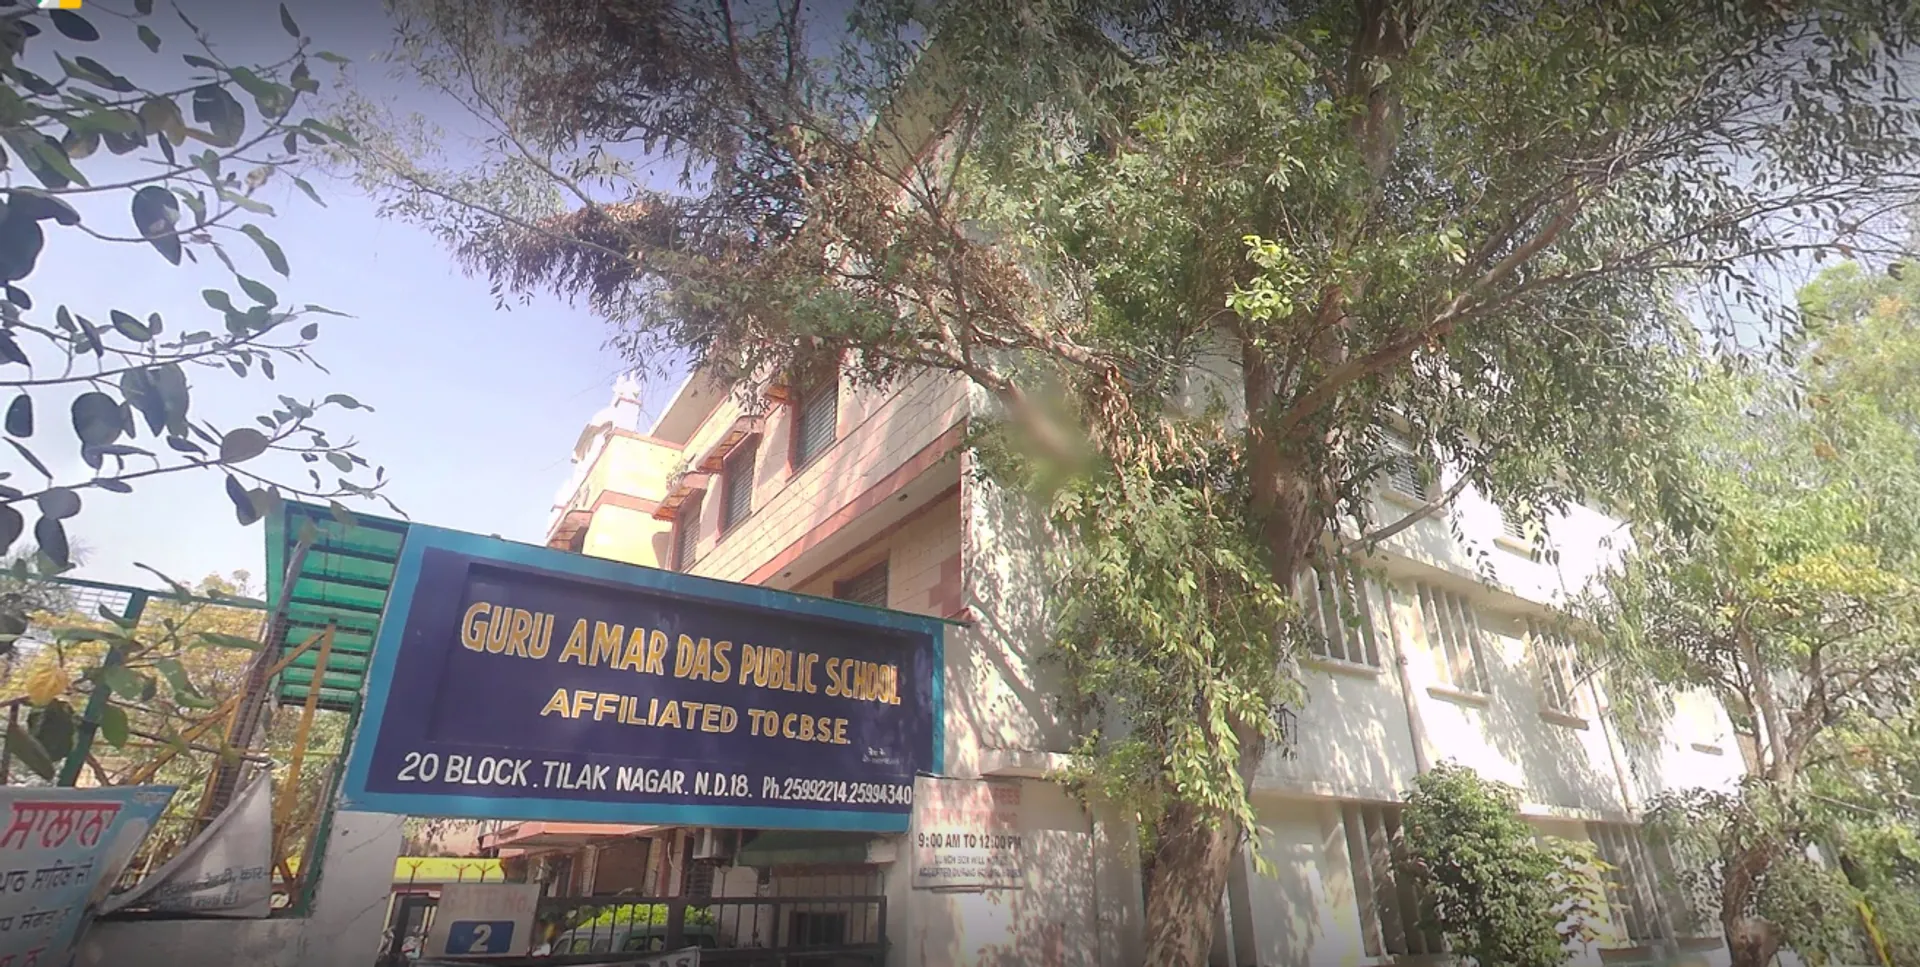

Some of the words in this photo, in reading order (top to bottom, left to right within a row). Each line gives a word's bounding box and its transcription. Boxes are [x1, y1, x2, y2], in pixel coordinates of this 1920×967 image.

[461, 602, 554, 659] GURU
[558, 618, 668, 676] AMAR
[674, 634, 732, 683] DAS
[739, 643, 819, 694] PUBLIC
[825, 657, 901, 705] SCHOOL
[540, 688, 738, 733] AFFILIATED
[748, 709, 779, 737] TO
[397, 752, 439, 782] 20
[0, 802, 124, 849] ਸਾਲਾਨਾ
[918, 832, 943, 848] 9:00
[945, 834, 961, 848] AM
[963, 834, 977, 848] TO
[979, 834, 1006, 849] 12:00
[469, 924, 492, 952] 2
